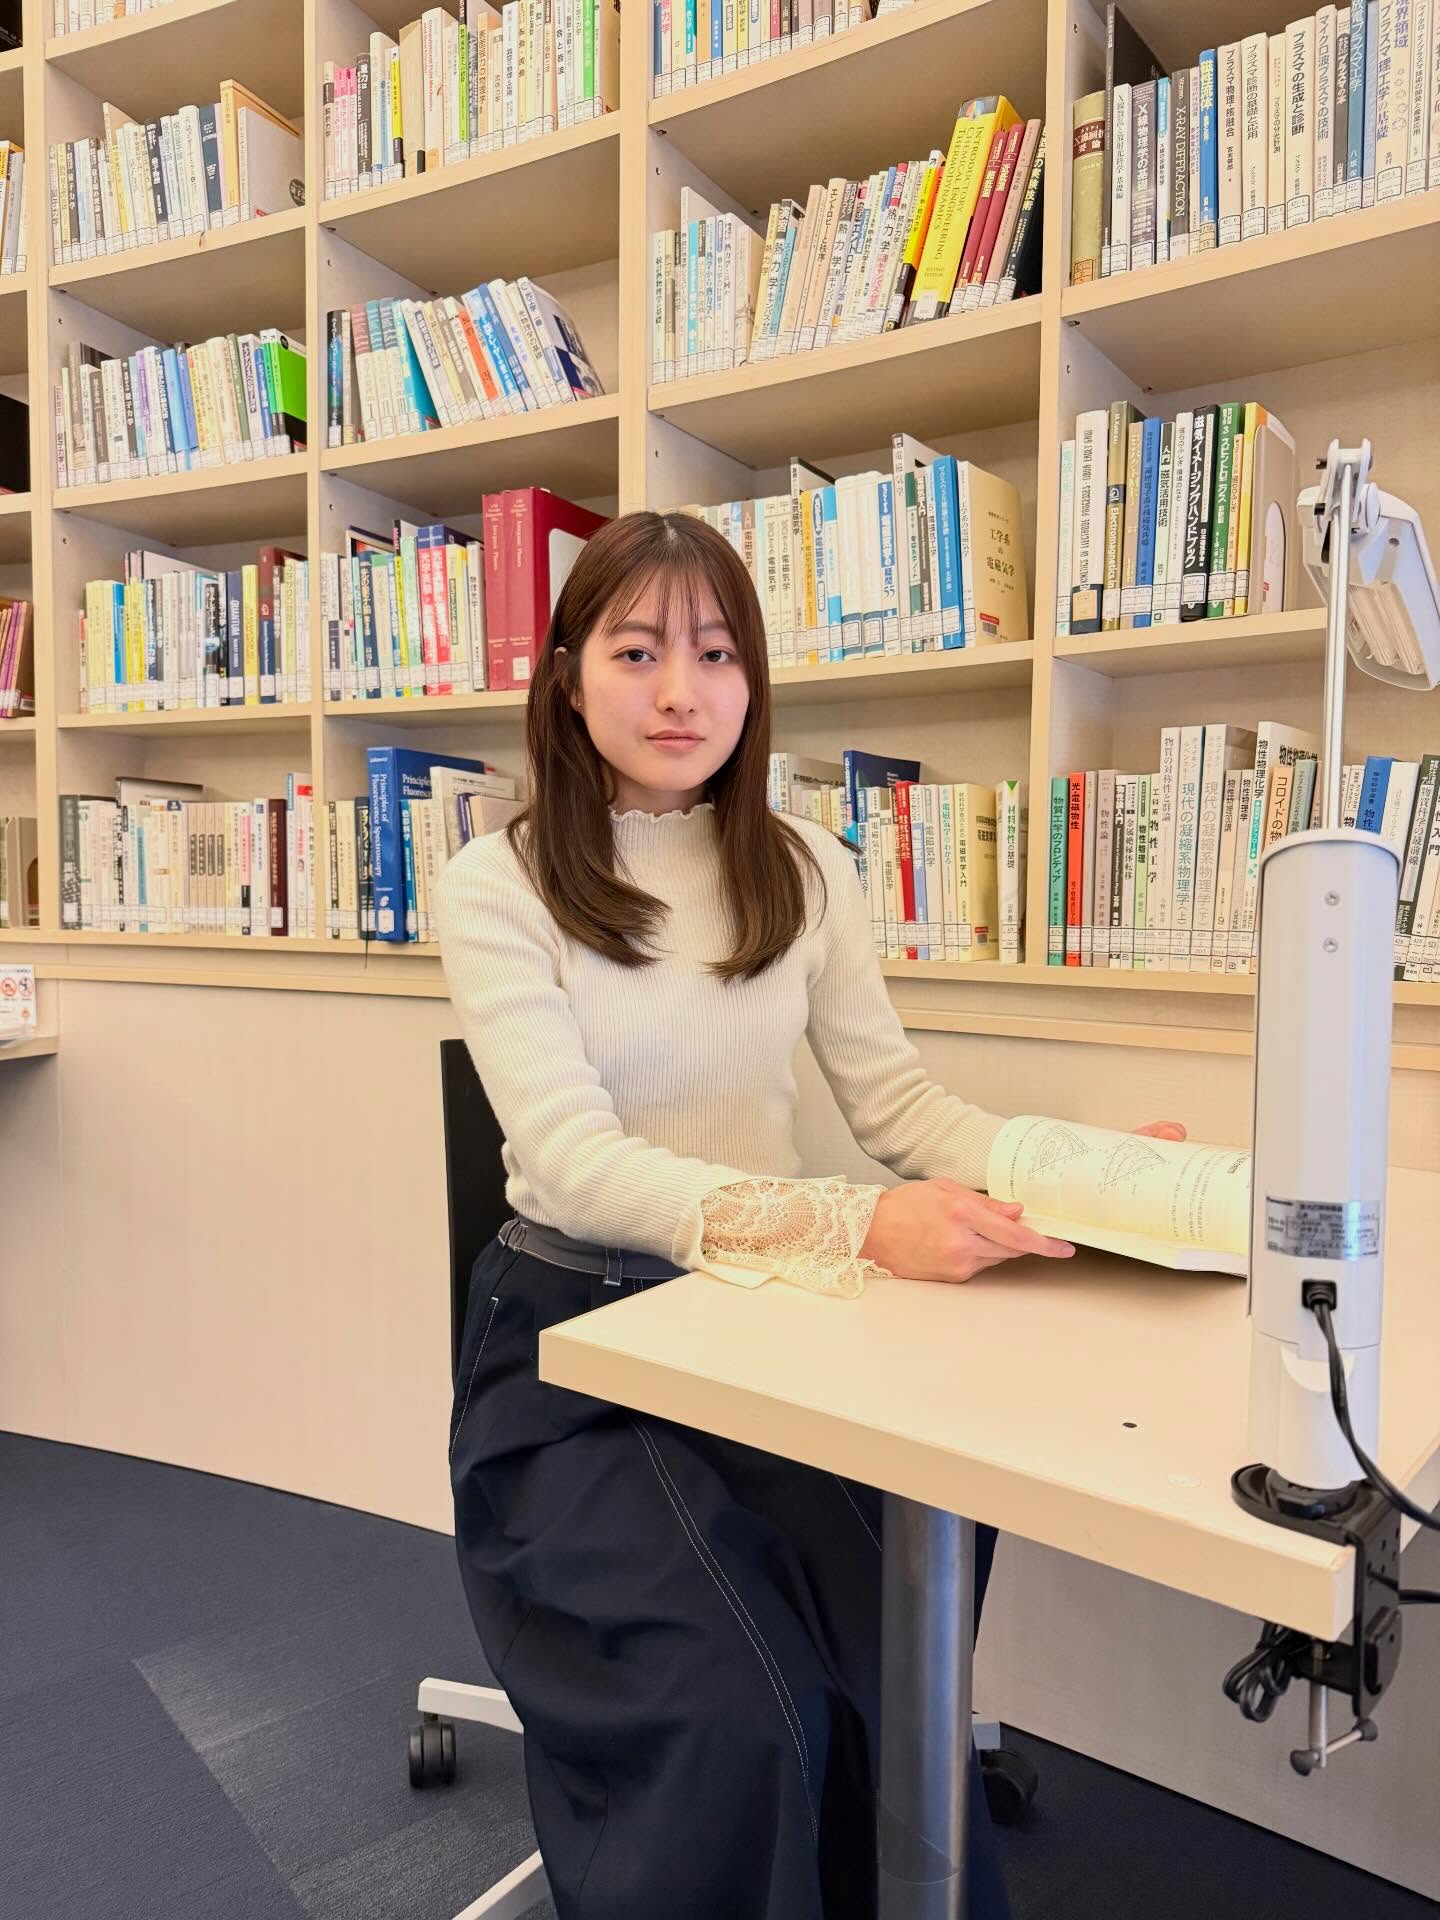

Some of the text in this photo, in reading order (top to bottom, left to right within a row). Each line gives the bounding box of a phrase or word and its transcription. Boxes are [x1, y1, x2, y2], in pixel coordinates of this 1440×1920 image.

[1226, 50, 1236, 138] プラズマ物理・核融合
[1291, 31, 1305, 137] プラズマの生成と診断
[1317, 15, 1330, 142] マイクロ波プラズマの技術
[1377, 5, 1391, 141] プラズマ理工学の基礎
[933, 127, 967, 230] THERMODYNAMICS
[956, 126, 986, 212] INTRODUCTORY
[1176, 105, 1186, 217] X-RAY DIFFRACTION
[817, 188, 838, 260] エントロピーと秩序
[937, 127, 975, 261] CHEMICAL ENGINEERING
[831, 221, 849, 269] 熱力学
[879, 207, 898, 254] 熱力学
[769, 242, 784, 288] 熱力学
[1157, 469, 1170, 528] 磁気活用技術
[1184, 415, 1205, 568] 磁気イメージングハンドブック
[1217, 437, 1231, 503] スピントロニクス
[986, 557, 1017, 578] 電磁気学
[1108, 506, 1120, 578] Electromagnetics
[230, 598, 241, 636] QUANTUM
[379, 773, 389, 823] Principles of
[402, 773, 431, 788] Principle
[403, 786, 432, 799] Fluoresc
[1254, 740, 1270, 798] 物性物理化学
[371, 773, 382, 877] Fluorescence Spectroscopy
[1070, 782, 1081, 830] 光・電磁物性
[1099, 809, 1110, 840] 物性論
[1240, 779, 1251, 822] 物性物理学
[1270, 777, 1288, 842] コロイドの物
[1343, 816, 1355, 828] 物
[1362, 809, 1376, 834] 物性
[1408, 787, 1433, 866] 物質科学の最前線
[926, 825, 936, 868] 電磁気学
[959, 839, 968, 888] 電磁気学入門
[1007, 805, 1016, 869] 材料物性の基礎
[1051, 796, 1065, 884] 物質工学のフロンティア
[1125, 818, 1136, 880] 金属絶縁体転移
[1137, 824, 1147, 864] 物性物理
[1148, 820, 1160, 884] 物性工学
[885, 860, 893, 892] 電磁気学
